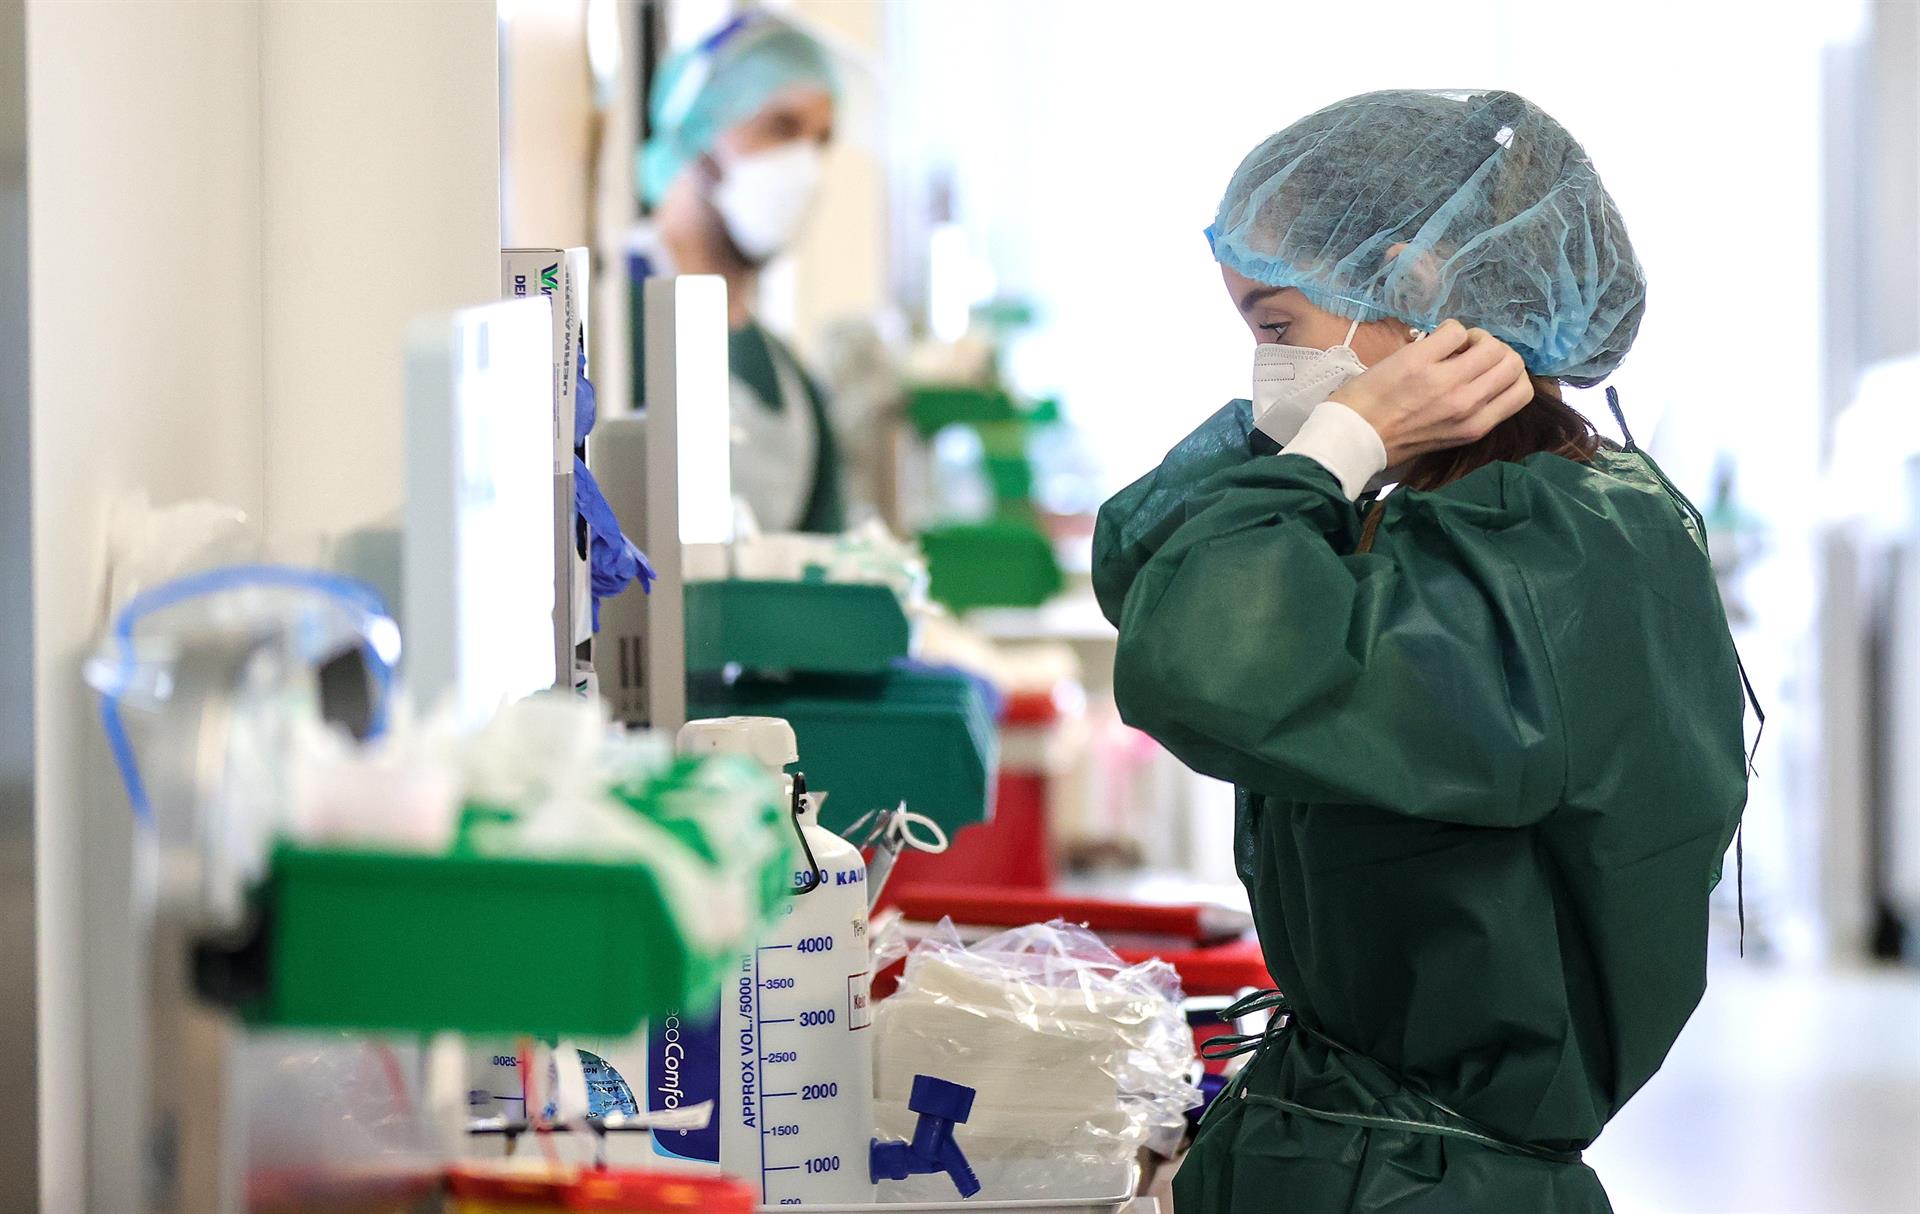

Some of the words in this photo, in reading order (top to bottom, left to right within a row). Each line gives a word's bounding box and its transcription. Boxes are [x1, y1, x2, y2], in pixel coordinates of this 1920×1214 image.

[795, 869, 828, 886] 500
[797, 936, 833, 953] 4000
[766, 978, 794, 989] 3500
[799, 1009, 835, 1027] 3000
[768, 1052, 797, 1063] 2500
[741, 1060, 756, 1129] APPROX
[801, 1082, 838, 1100] 2000
[771, 1125, 799, 1136] 1500
[804, 1156, 840, 1174] 1000
